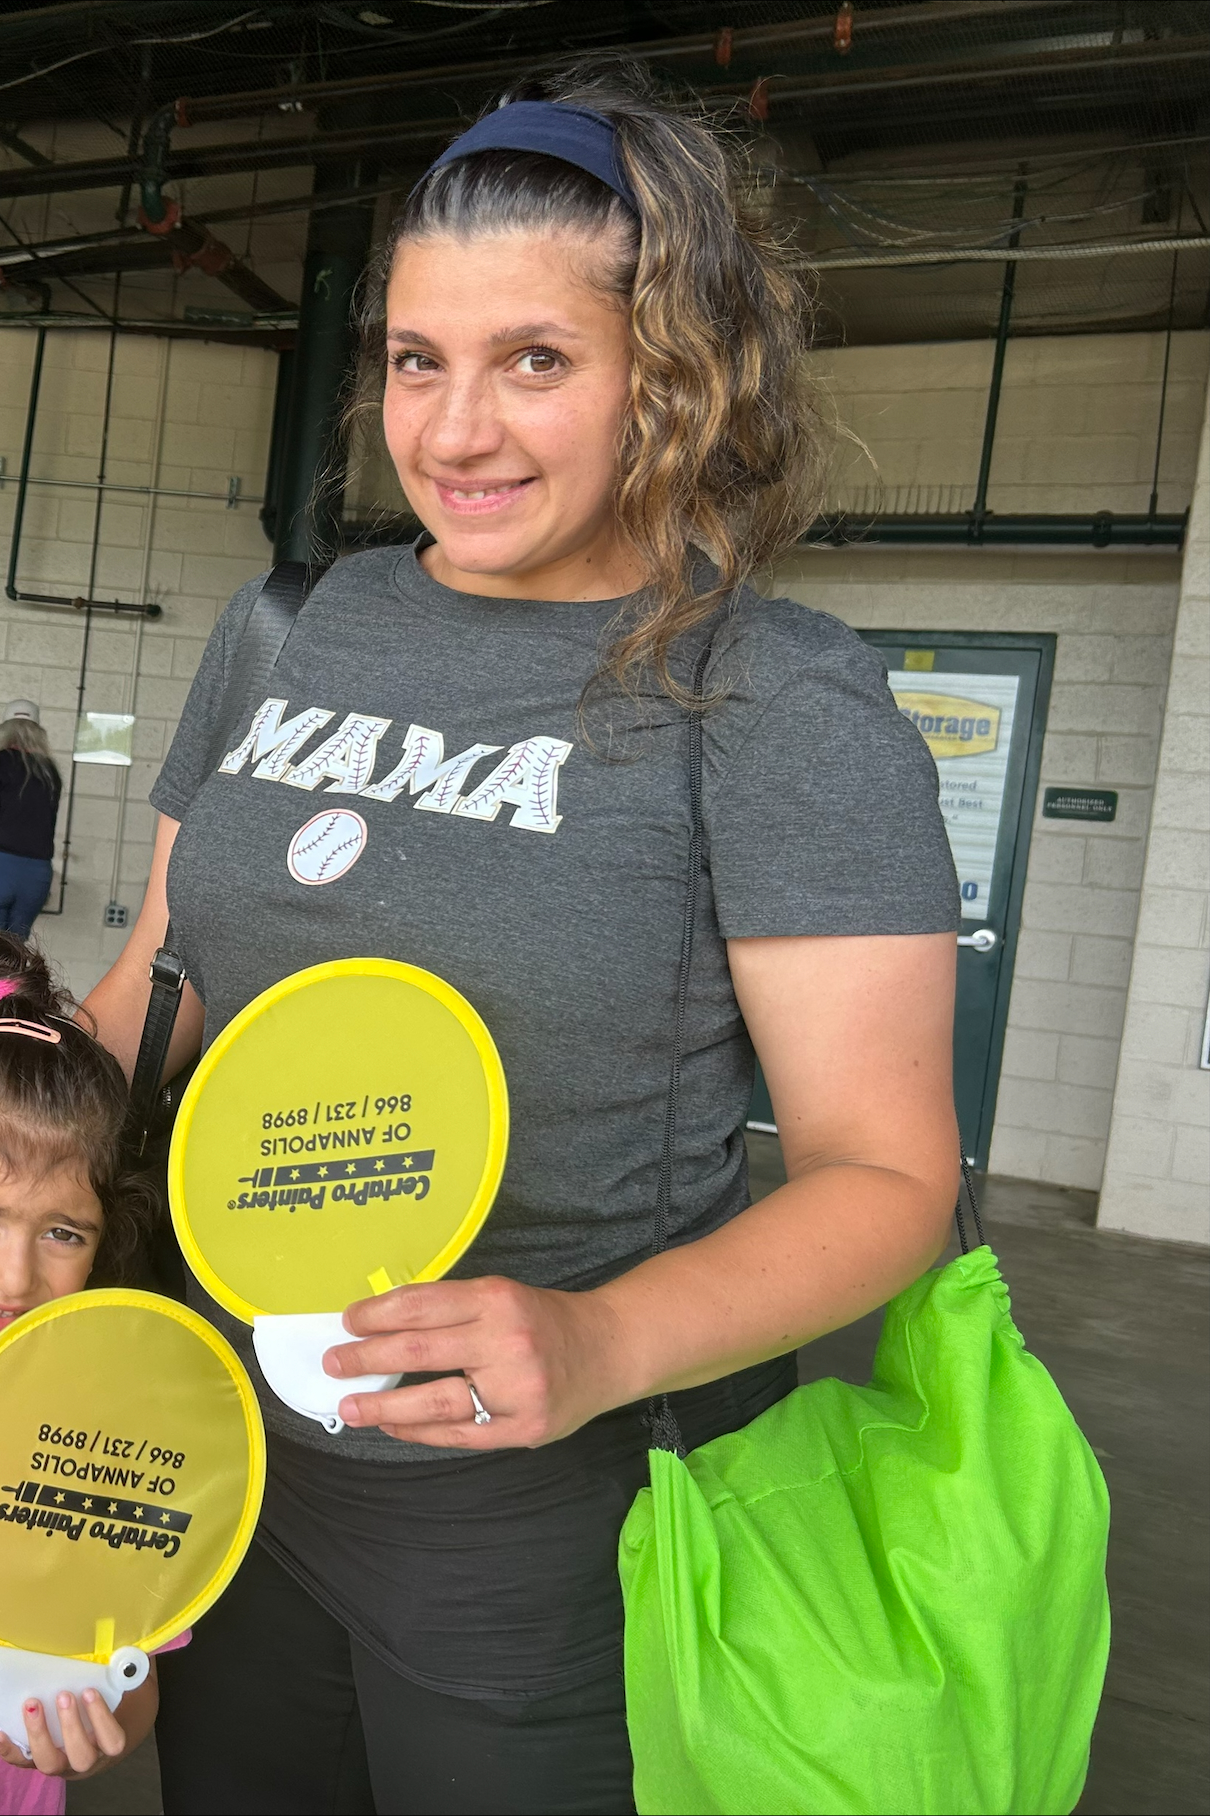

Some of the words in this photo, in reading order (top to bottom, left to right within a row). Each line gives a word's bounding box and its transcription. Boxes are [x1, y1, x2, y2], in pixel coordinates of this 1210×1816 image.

[217, 697, 574, 834] MAMA
[326, 1101, 357, 1122] 231
[374, 1094, 412, 1116] 866
[262, 1106, 308, 1130] 8998
[260, 1126, 376, 1157] ANNAPOLIS
[382, 1122, 412, 1144] OF
[331, 1174, 430, 1206] CertaPro
[38, 1423, 88, 1450] 8998
[102, 1436, 134, 1458] 231
[149, 1446, 186, 1469] 866
[30, 1451, 145, 1489] ANNAPOLIS
[146, 1475, 176, 1496] OF
[89, 1521, 181, 1559] CertaPro
